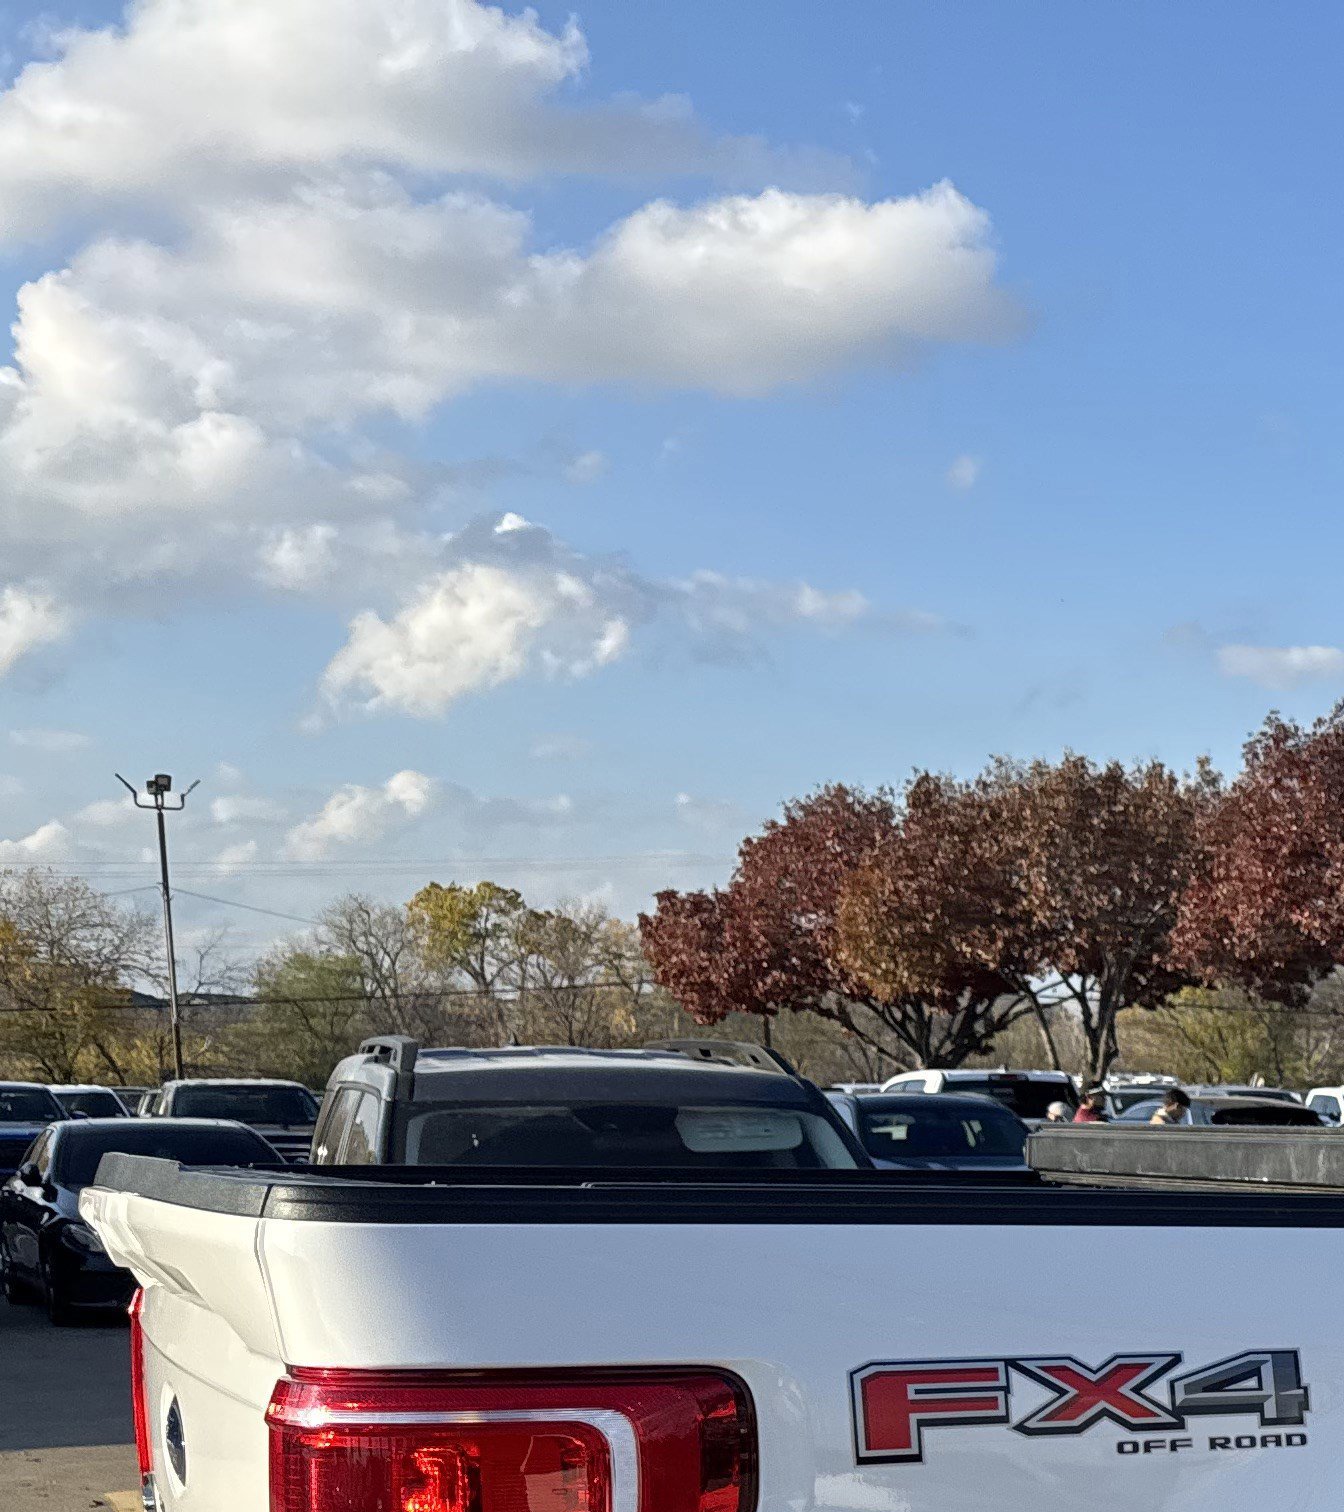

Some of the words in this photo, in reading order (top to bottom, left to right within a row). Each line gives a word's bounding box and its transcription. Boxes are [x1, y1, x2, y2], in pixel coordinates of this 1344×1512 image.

[848, 1348, 1310, 1466] FX4
[1116, 1438, 1194, 1455] OFF
[1208, 1432, 1309, 1452] ROAD
